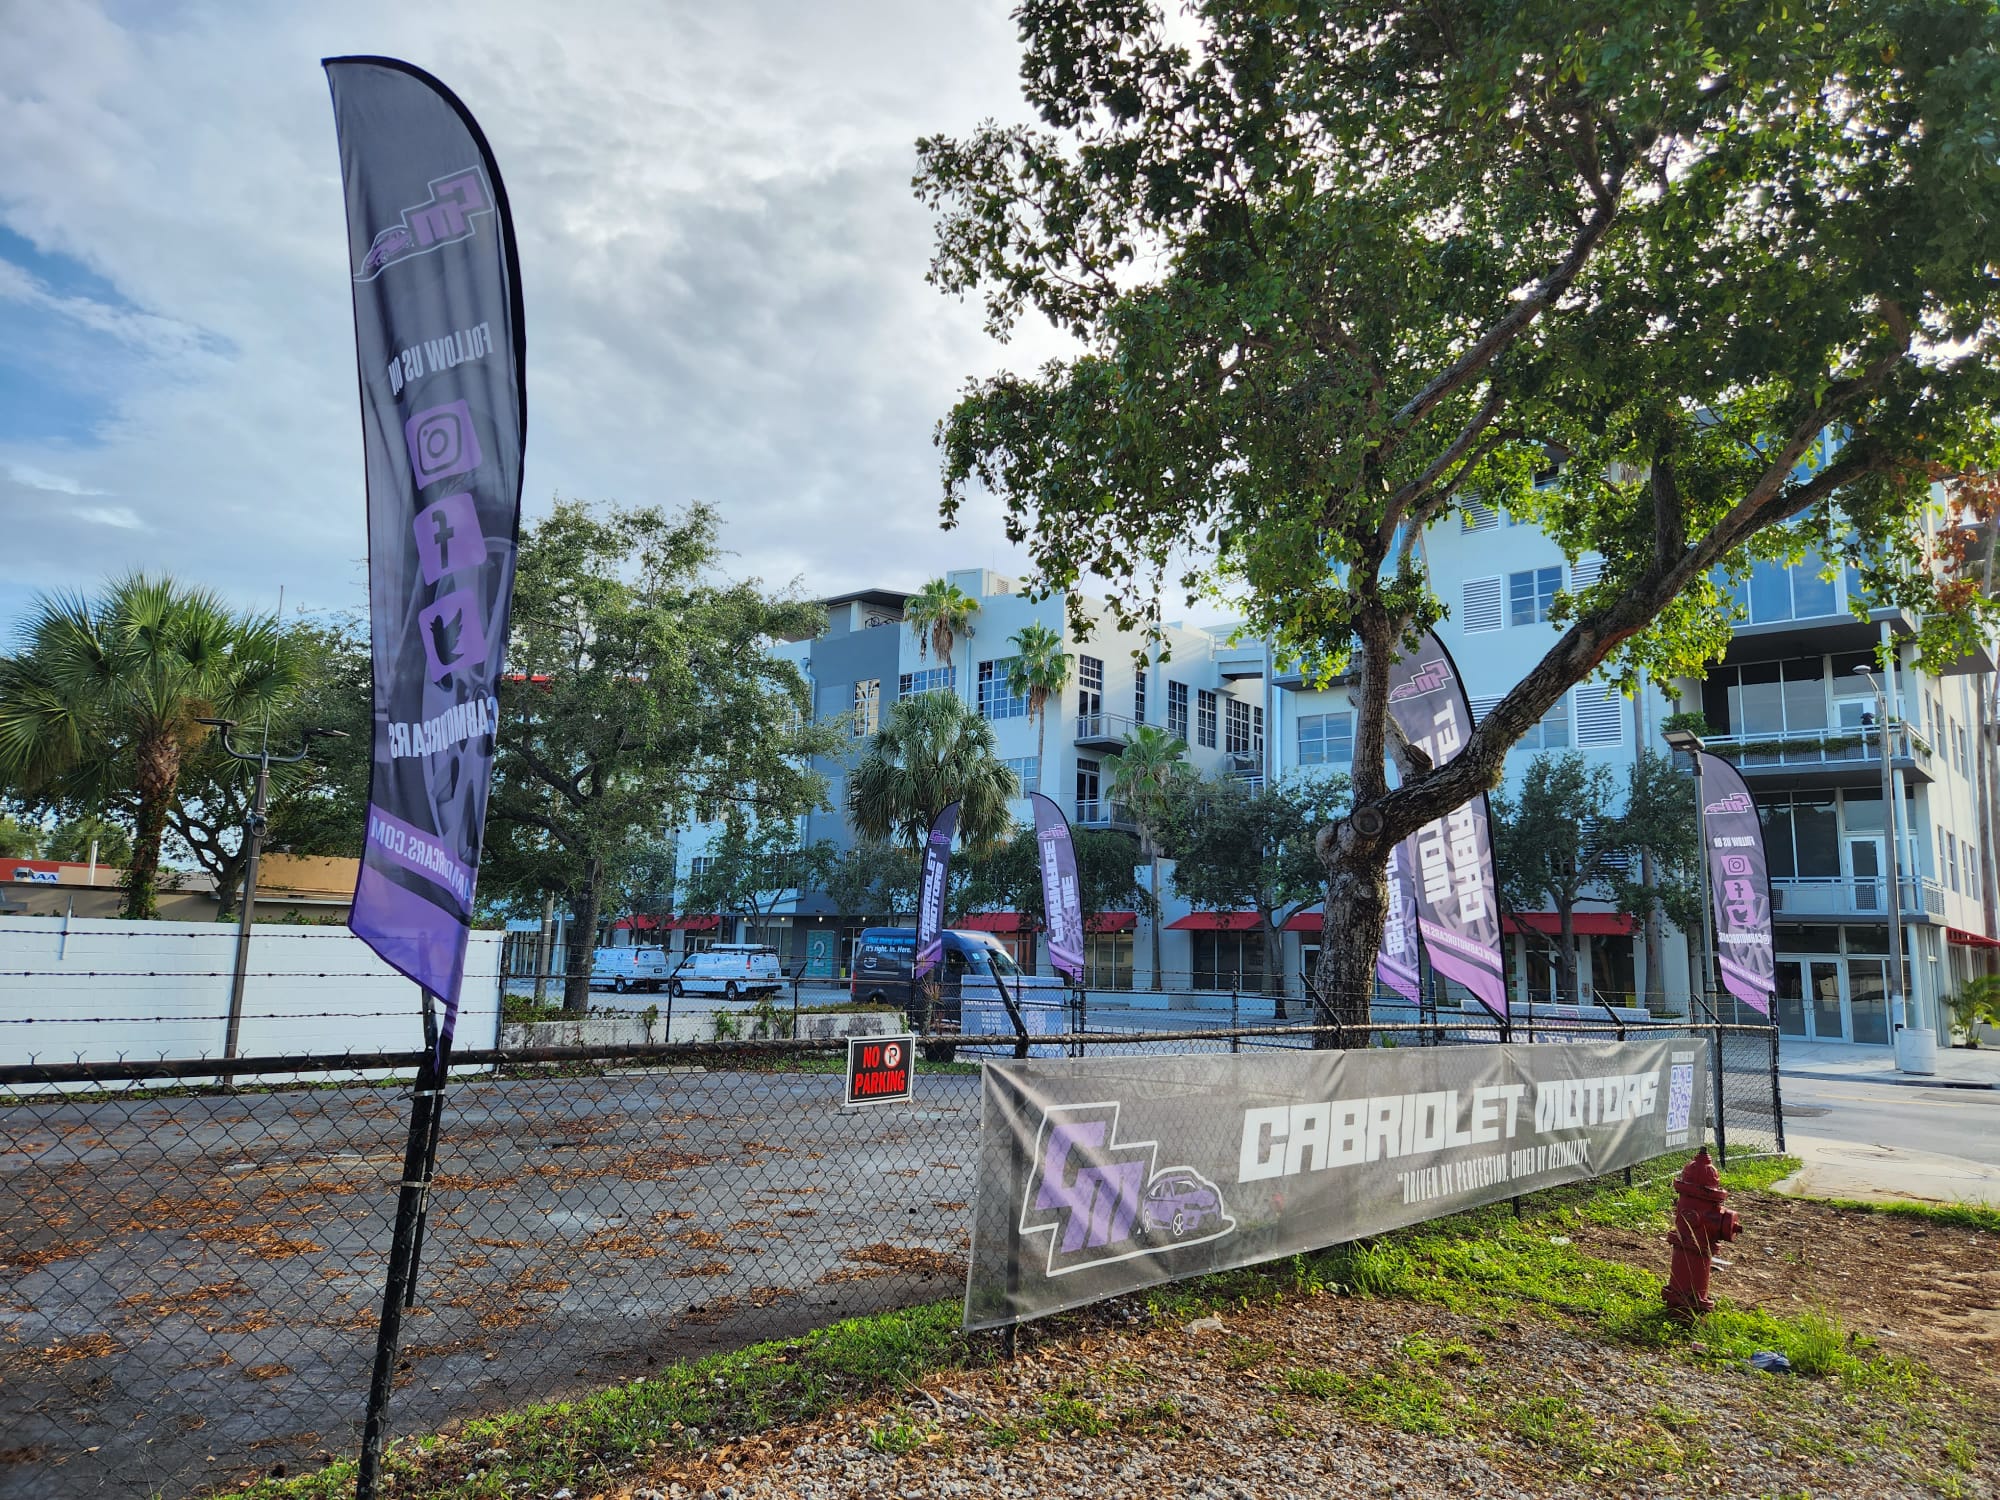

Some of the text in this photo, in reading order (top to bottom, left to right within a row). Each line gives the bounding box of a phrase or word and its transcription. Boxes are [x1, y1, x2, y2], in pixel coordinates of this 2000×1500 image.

[921, 848, 937, 942] CABRIOLET
[930, 861, 944, 934] MOTORS
[813, 940, 825, 967] 2
[874, 945, 888, 953] right.
[889, 945, 897, 953] In.
[898, 945, 912, 953] Here.
[863, 1045, 880, 1068] NO
[854, 1069, 905, 1096] PARKING
[1239, 1071, 1660, 1184] CABRIOLET MOTORS
[1441, 1163, 1454, 1196] BY
[1455, 1152, 1509, 1193] PERFECTION,
[1511, 1146, 1535, 1179] GUIDED
[1537, 1145, 1548, 1173] BY
